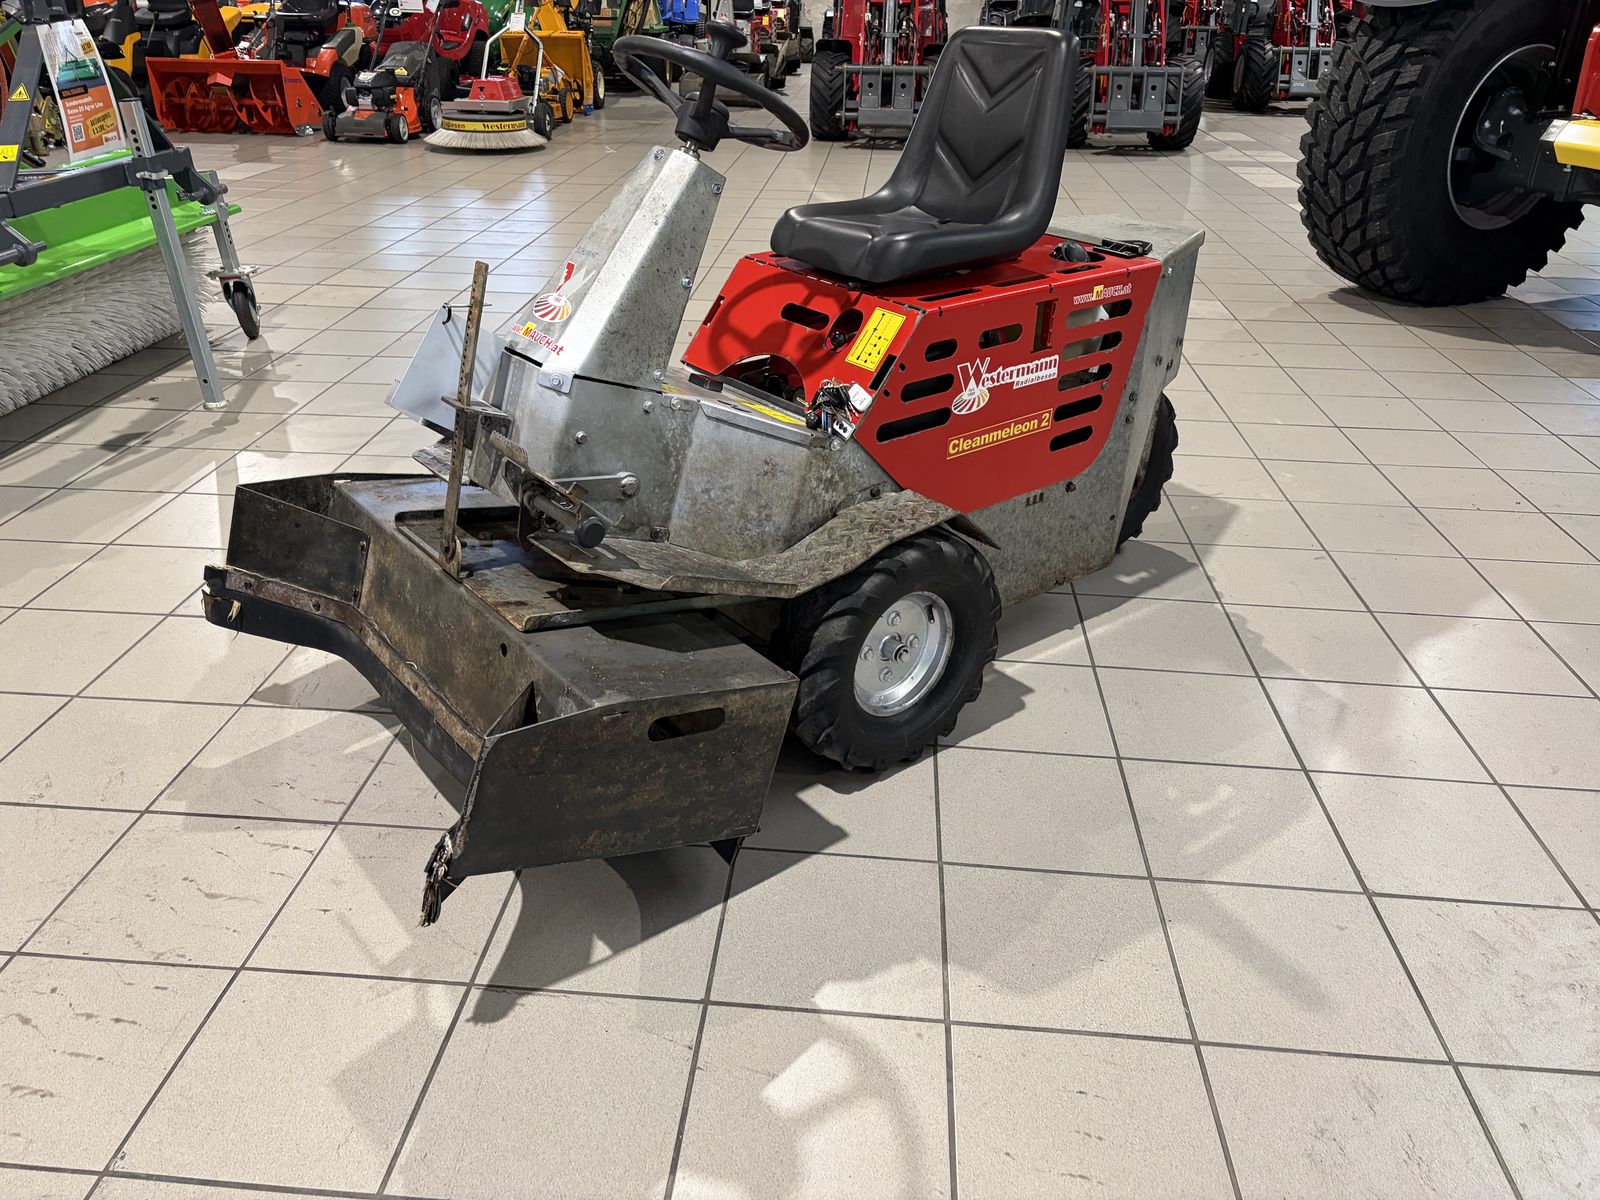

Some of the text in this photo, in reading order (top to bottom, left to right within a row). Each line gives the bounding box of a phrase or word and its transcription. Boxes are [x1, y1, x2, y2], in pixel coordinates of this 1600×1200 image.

[1073, 284, 1132, 305] www.MAUCH.at
[957, 355, 1059, 393] Westermann
[1014, 371, 1057, 388] Radialbesen
[948, 412, 1051, 455] Cleanmeleon 2
